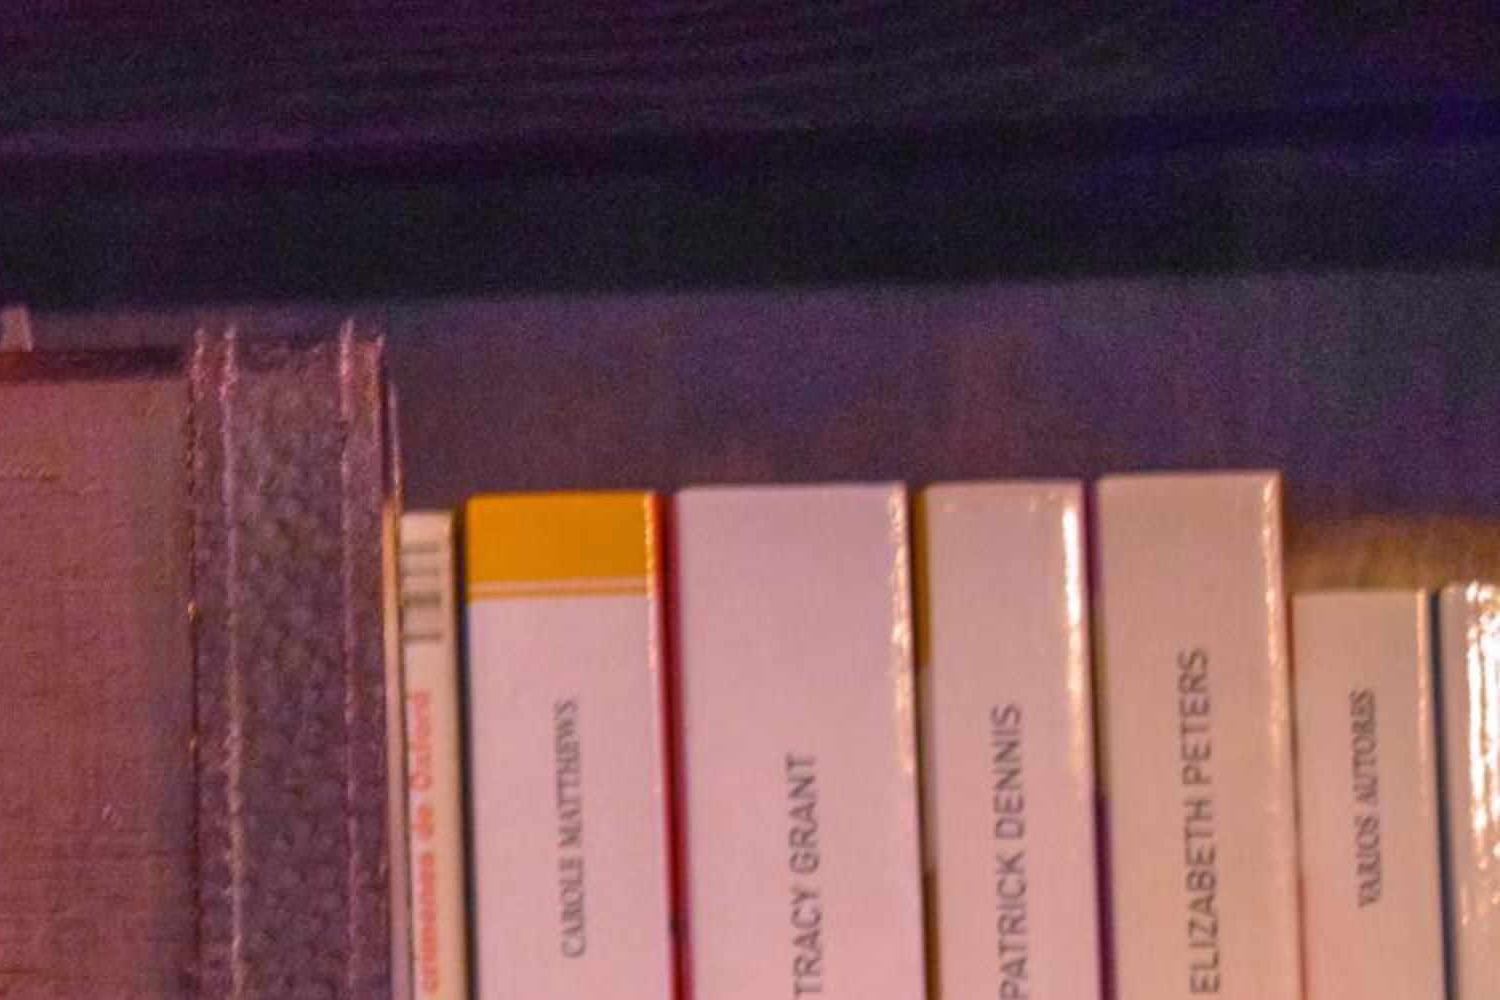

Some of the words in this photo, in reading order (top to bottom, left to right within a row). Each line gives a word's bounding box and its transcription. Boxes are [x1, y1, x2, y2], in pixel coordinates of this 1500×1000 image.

[410, 692, 432, 791] Oxford
[554, 700, 583, 848] MATTHEWS
[991, 704, 1025, 837] DENNIS
[1178, 648, 1212, 785] PETERS
[1350, 689, 1378, 811] AUTORES
[412, 805, 435, 841] de
[786, 753, 819, 875] GRANT
[1354, 815, 1382, 907] VARIOS
[561, 856, 586, 958] CAROLE
[793, 886, 823, 1000] TRACY
[996, 852, 1028, 1000] PATRICK
[1183, 801, 1219, 994] ELIZABETH
